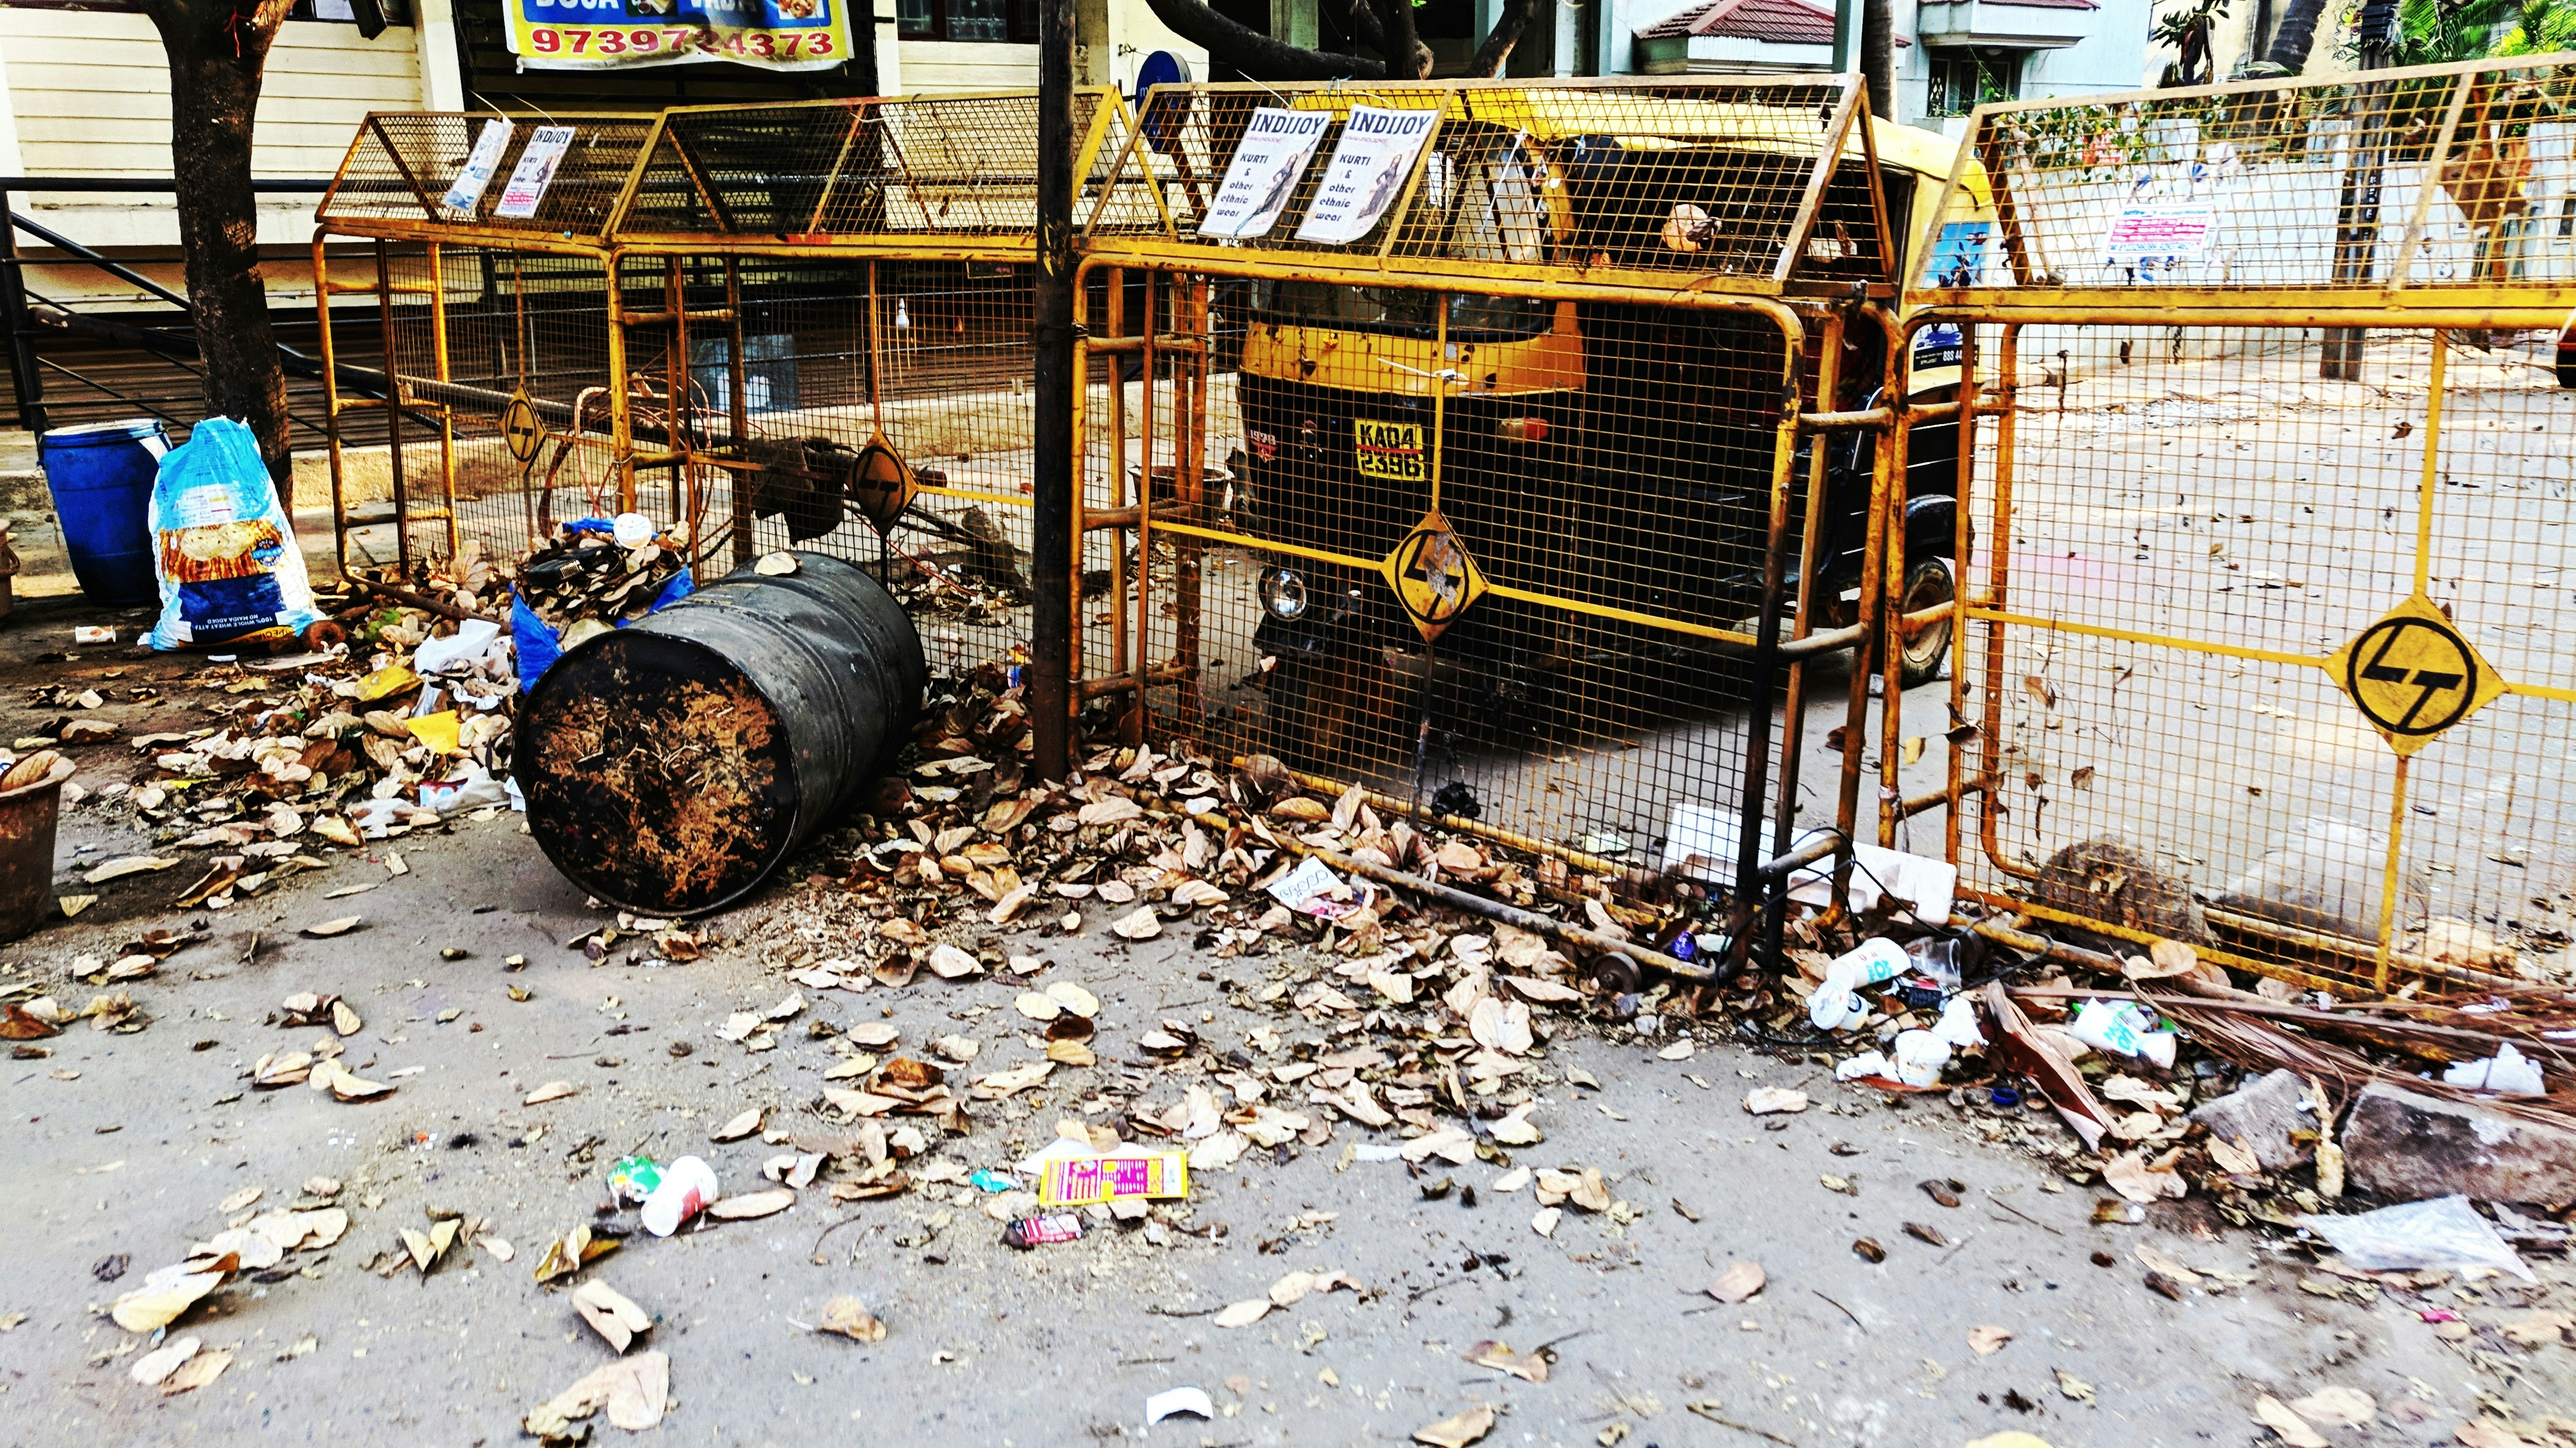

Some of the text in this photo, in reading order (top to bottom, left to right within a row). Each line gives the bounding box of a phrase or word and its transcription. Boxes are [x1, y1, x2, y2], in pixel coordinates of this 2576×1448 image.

[1250, 113, 1326, 135] INDIJOY
[1349, 111, 1432, 135] INDIJOY
[1240, 153, 1269, 164] KURTI
[1339, 154, 1372, 166] KURTI
[1244, 168, 1251, 176] &
[1345, 170, 1352, 179] &
[1229, 180, 1254, 190] other
[1329, 184, 1355, 194] other
[1221, 194, 1249, 204] ethnic
[1320, 197, 1351, 208] ethnic
[1316, 213, 1342, 222] wear
[1359, 424, 1415, 449] KA04
[257, 616, 273, 624] 100%
